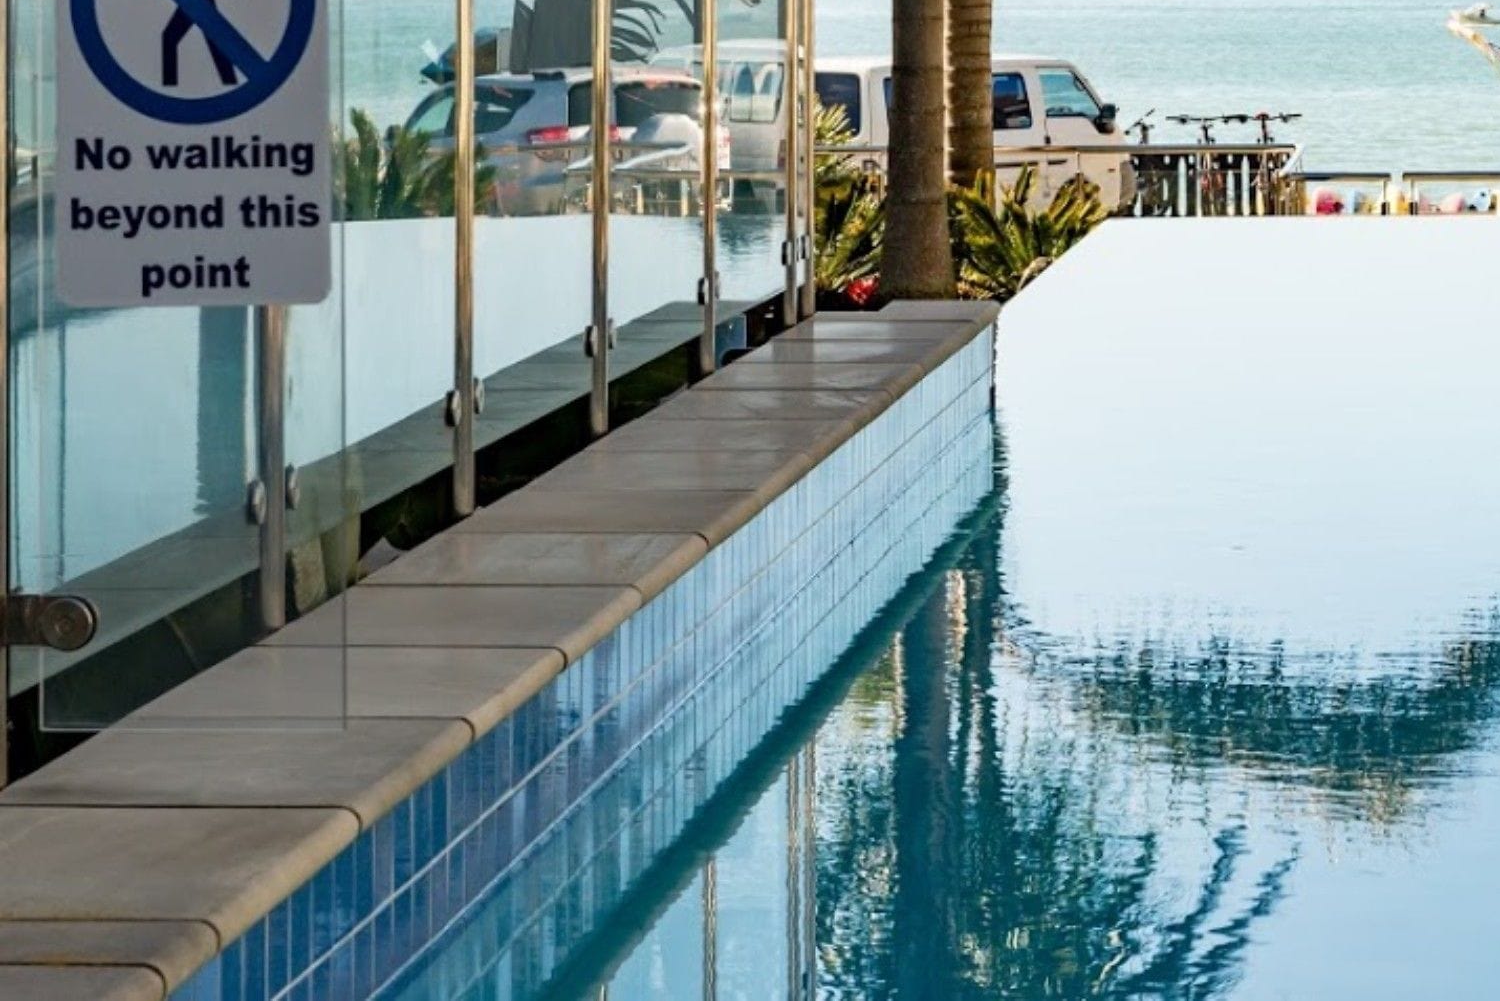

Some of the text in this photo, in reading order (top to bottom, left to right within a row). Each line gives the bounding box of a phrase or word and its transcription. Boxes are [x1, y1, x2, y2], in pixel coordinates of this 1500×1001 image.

[75, 135, 315, 176] No walking
[70, 194, 320, 238] beyond this
[141, 256, 250, 297] point
